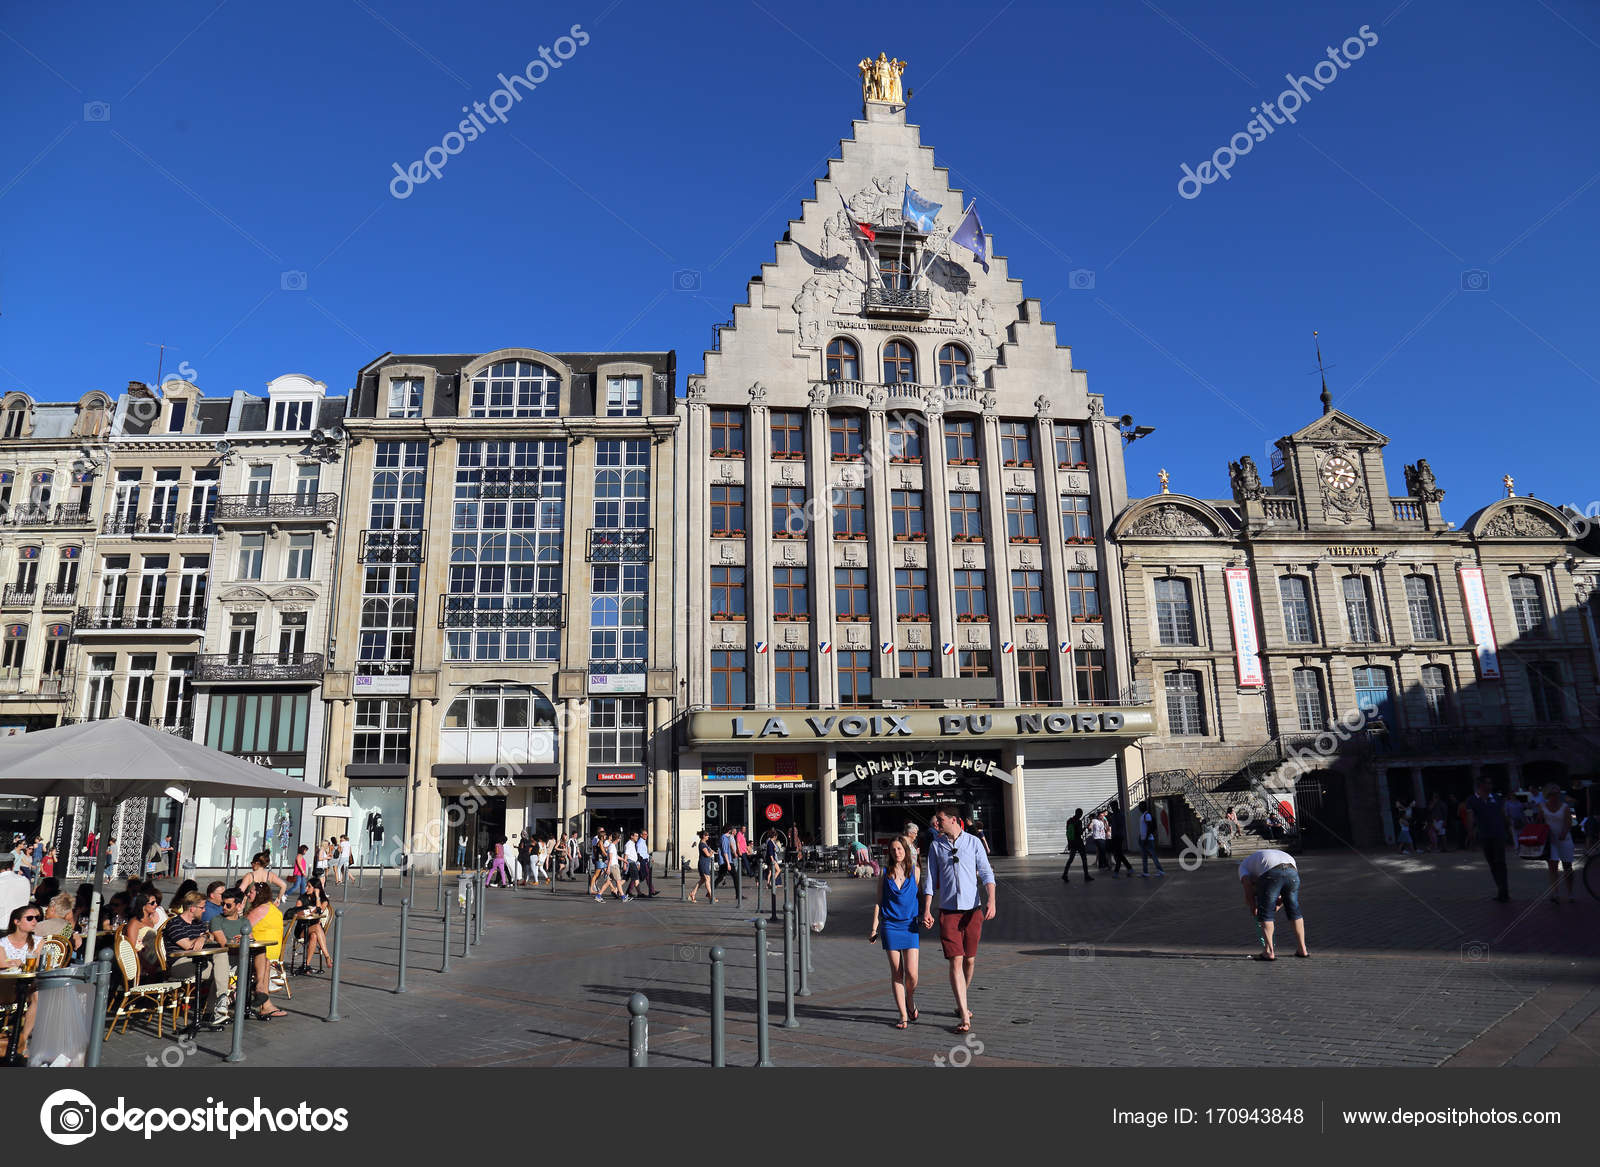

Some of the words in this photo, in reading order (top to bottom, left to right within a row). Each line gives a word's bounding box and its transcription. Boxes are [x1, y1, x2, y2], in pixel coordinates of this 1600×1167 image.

[1327, 546, 1380, 556] THEATRE
[732, 716, 790, 738] LA
[806, 715, 913, 738] VOIX
[940, 714, 993, 735] DU
[1016, 712, 1125, 734] NORD
[937, 750, 997, 777] PLACE
[479, 777, 516, 786] ZARA
[892, 767, 957, 786] fnac
[706, 801, 718, 819] 8
